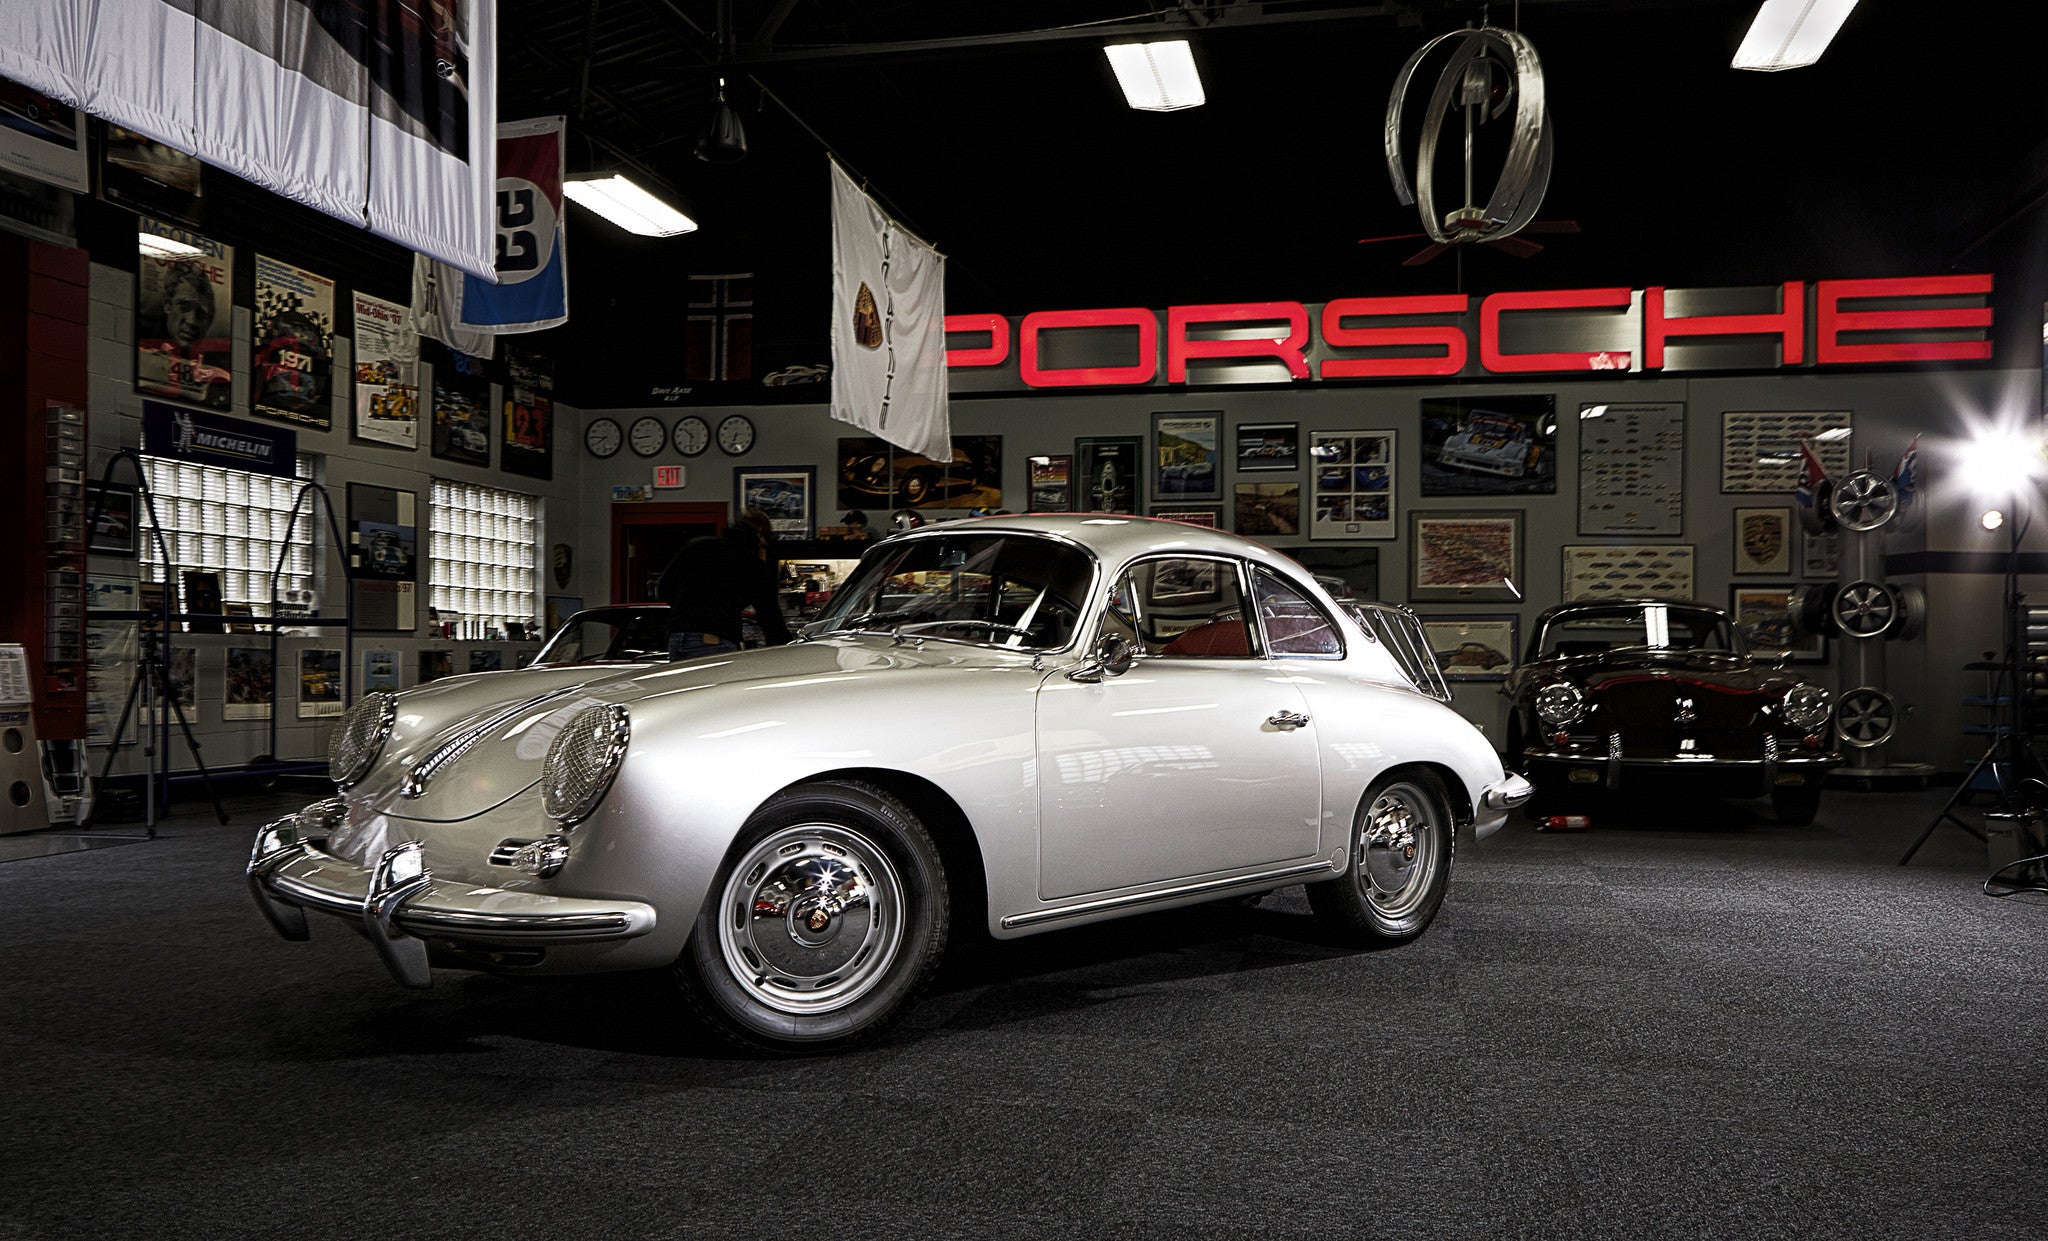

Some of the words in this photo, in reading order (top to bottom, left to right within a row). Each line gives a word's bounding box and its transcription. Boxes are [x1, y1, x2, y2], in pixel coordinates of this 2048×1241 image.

[255, 404, 329, 427] PORSCHE
[196, 432, 272, 457] MICHELIN
[657, 467, 681, 486] EXIT
